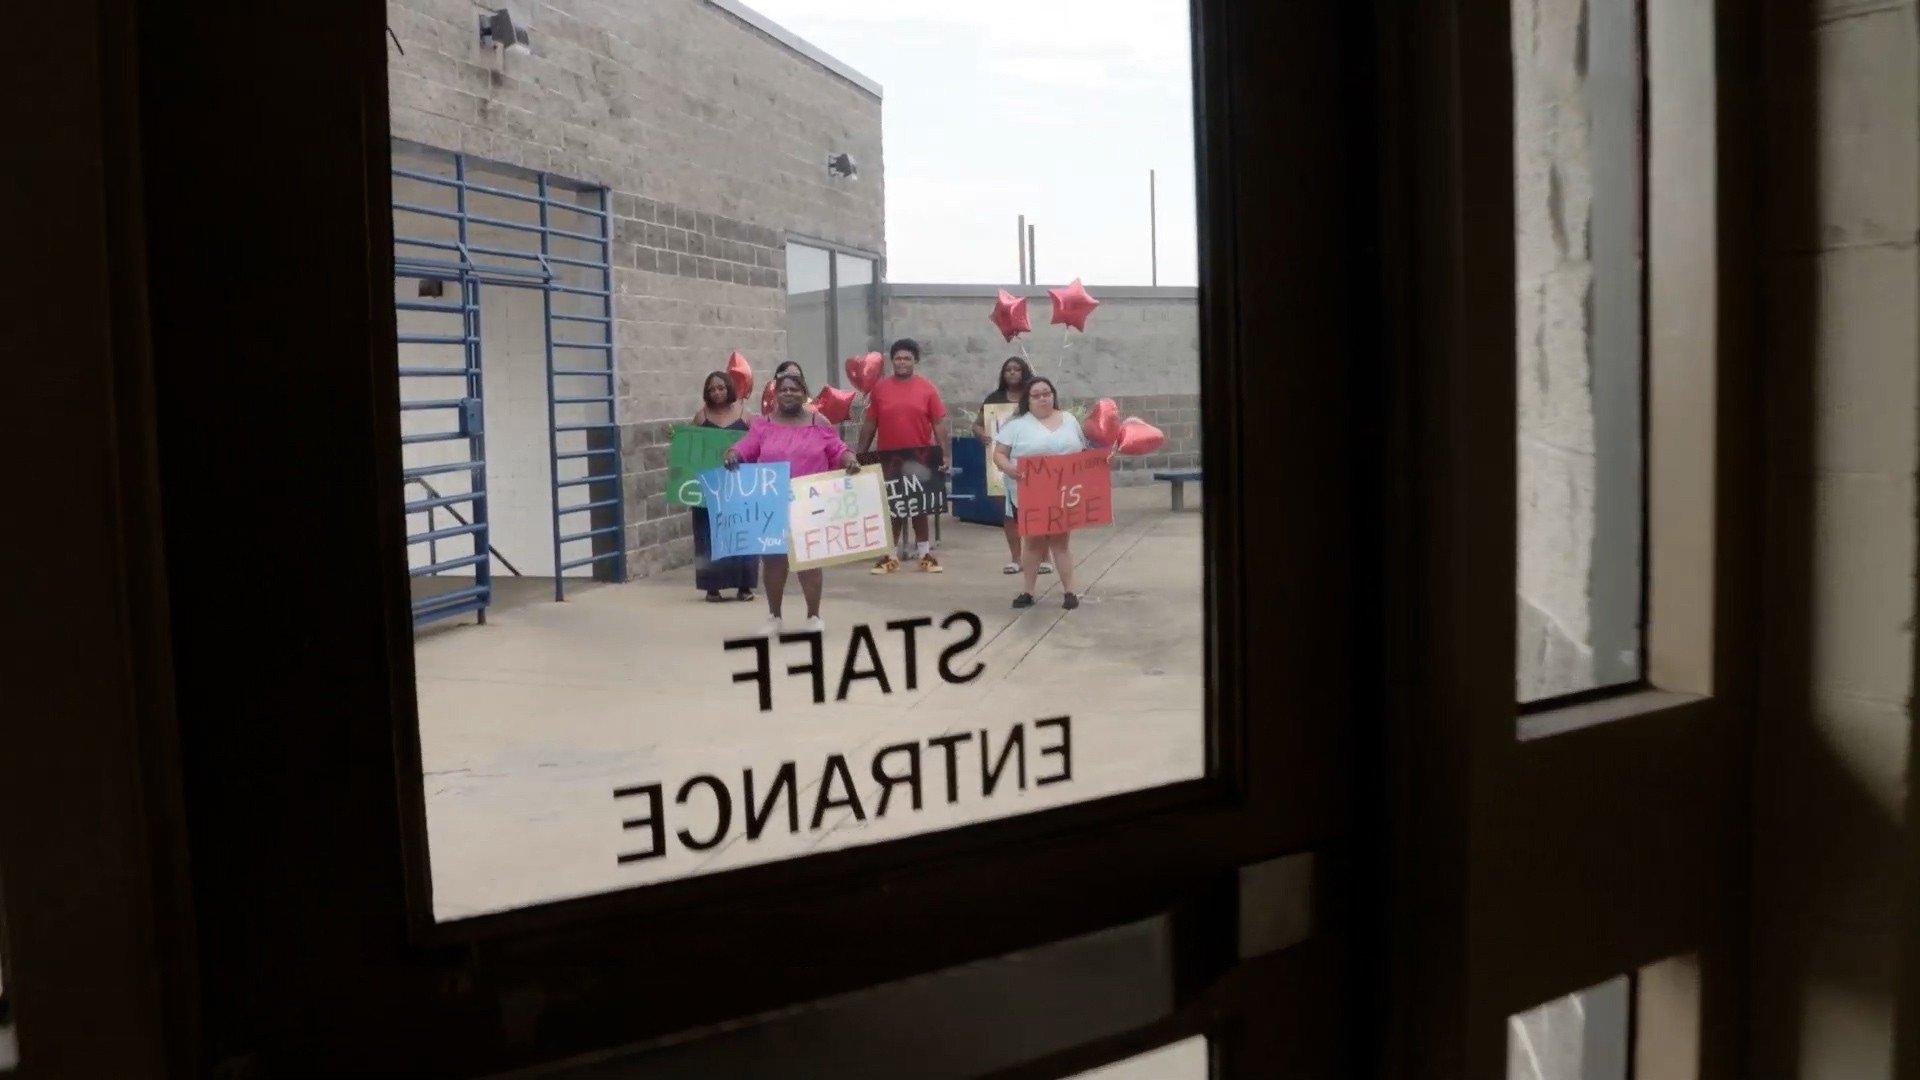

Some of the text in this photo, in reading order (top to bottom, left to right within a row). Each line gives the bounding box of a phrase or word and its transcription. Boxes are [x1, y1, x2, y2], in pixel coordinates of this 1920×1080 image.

[701, 467, 778, 513] YOUR
[1024, 457, 1064, 490] My
[1024, 496, 1102, 535] FREE
[804, 514, 881, 560] FREE
